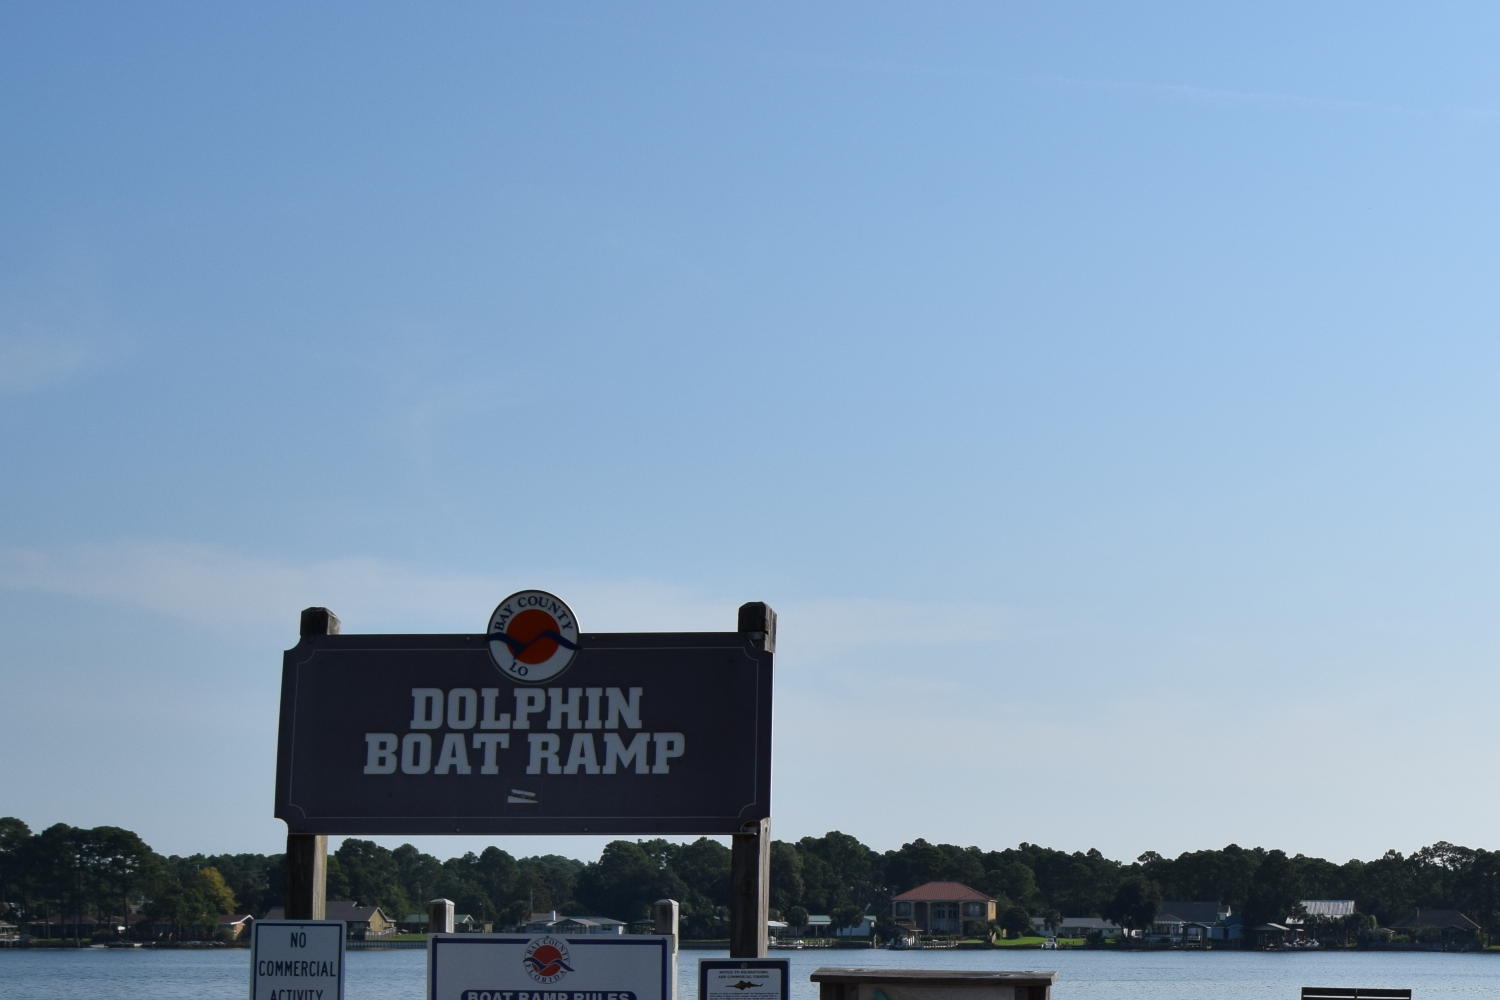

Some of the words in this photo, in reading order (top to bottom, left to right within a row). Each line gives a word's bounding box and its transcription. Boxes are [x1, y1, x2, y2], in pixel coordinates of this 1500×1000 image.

[495, 604, 515, 631] BAY
[517, 595, 573, 629] COUNTY
[410, 687, 643, 730] DOLPHIN
[363, 733, 510, 775] BOAT
[525, 732, 686, 775] RAMP
[290, 932, 307, 948] NO
[526, 942, 540, 955] BAY
[543, 938, 568, 961] COUNTY
[258, 960, 336, 977] COMMERCIAL
[525, 961, 567, 981] FLORIDA
